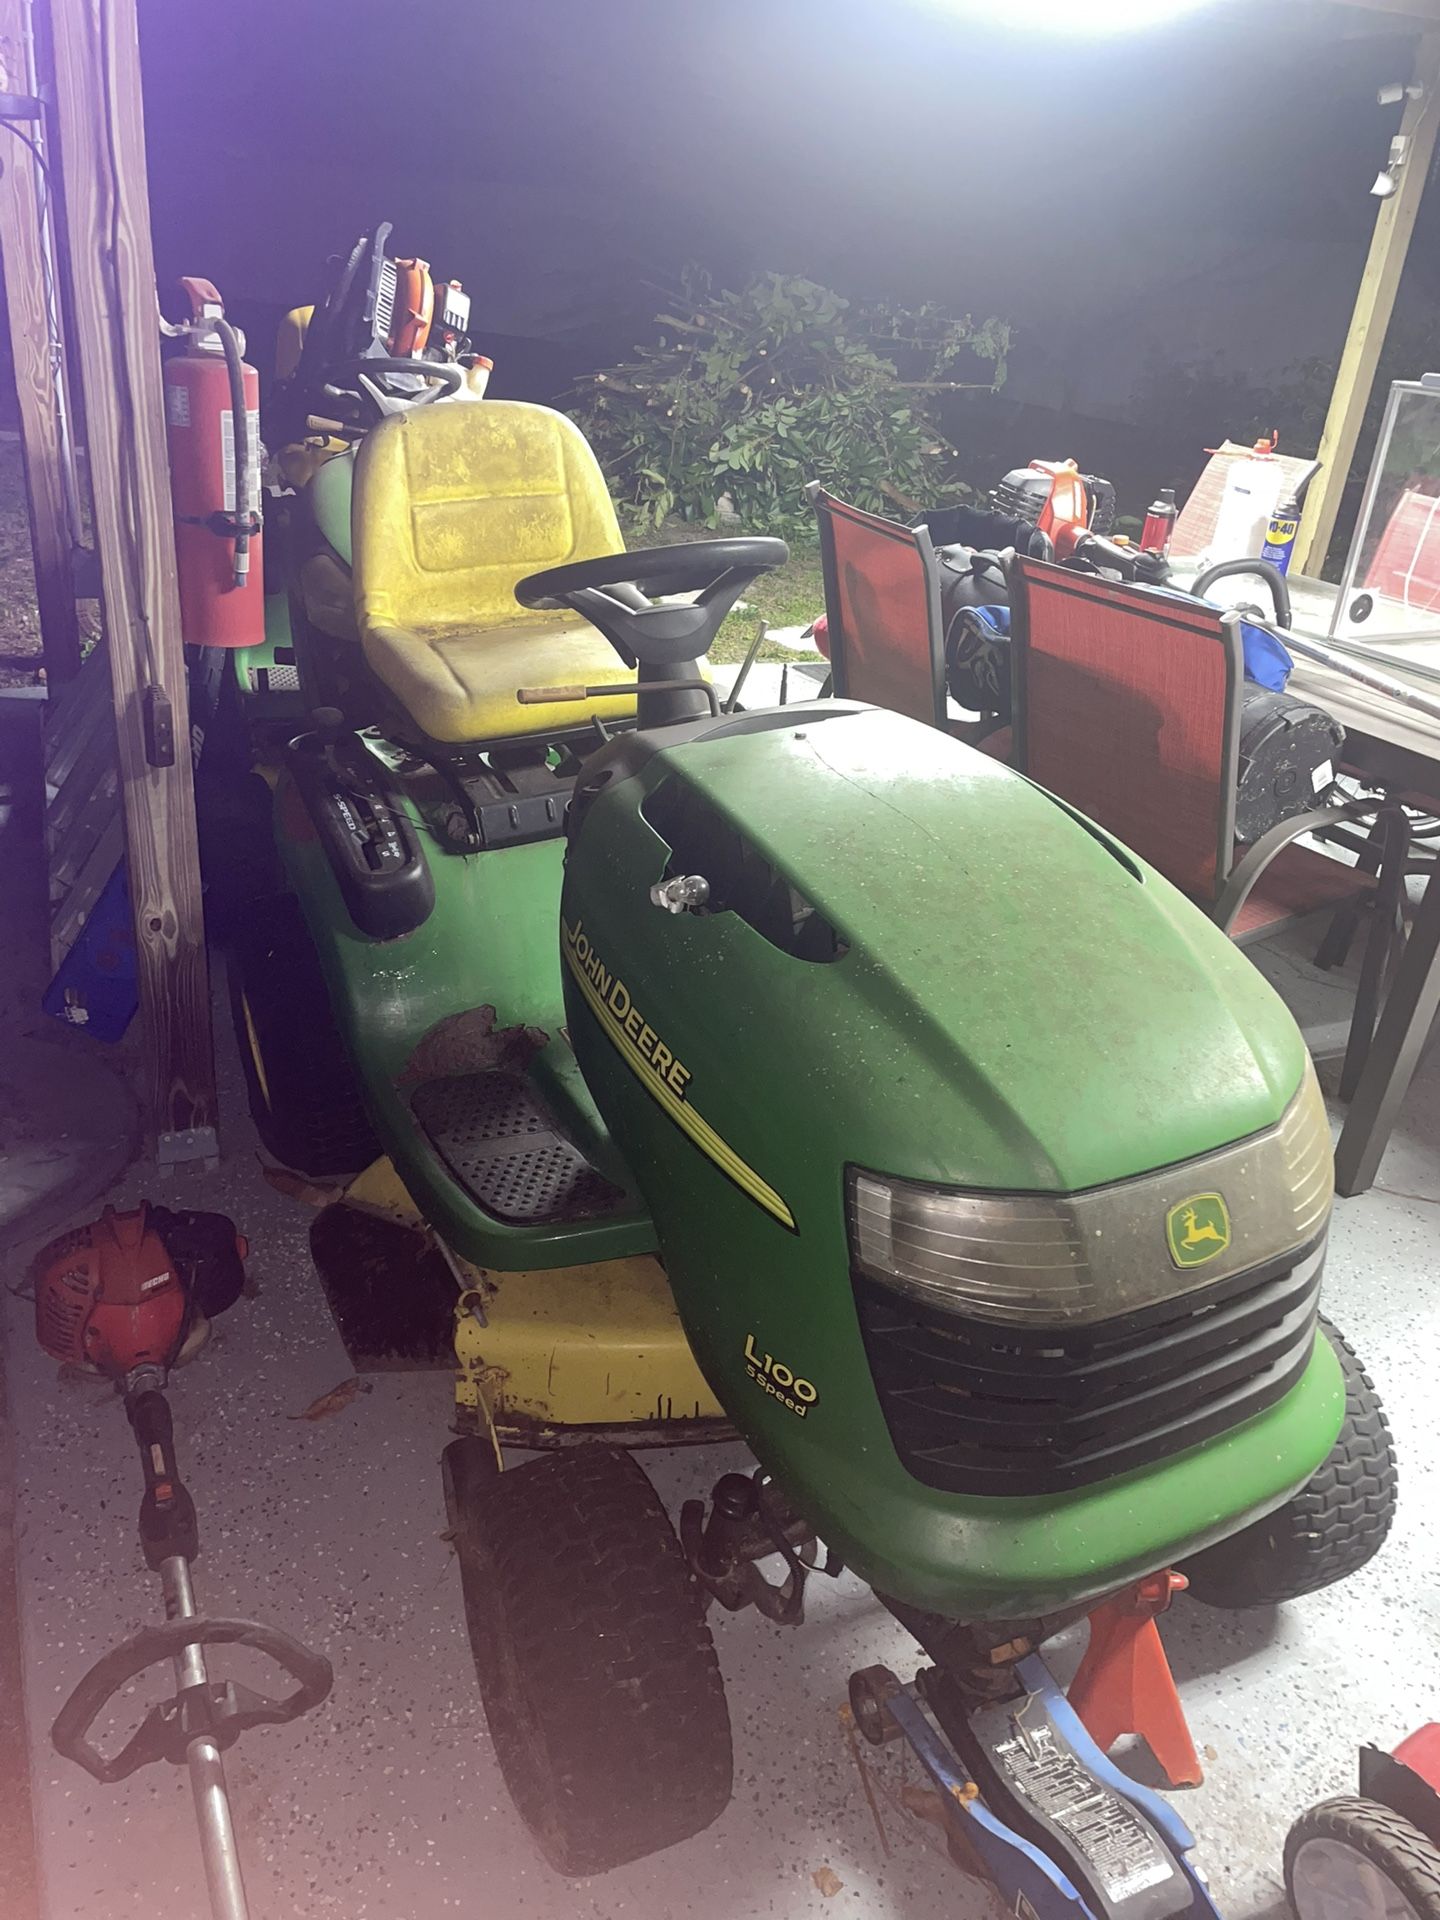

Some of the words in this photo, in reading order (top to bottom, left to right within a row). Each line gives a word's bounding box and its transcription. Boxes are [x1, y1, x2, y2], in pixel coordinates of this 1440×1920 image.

[567, 920, 611, 1000] JOHN
[608, 978, 692, 1096] DEERE
[744, 1333, 818, 1403] L100
[745, 1364, 757, 1379] 5
[756, 1374, 807, 1417] Speed
